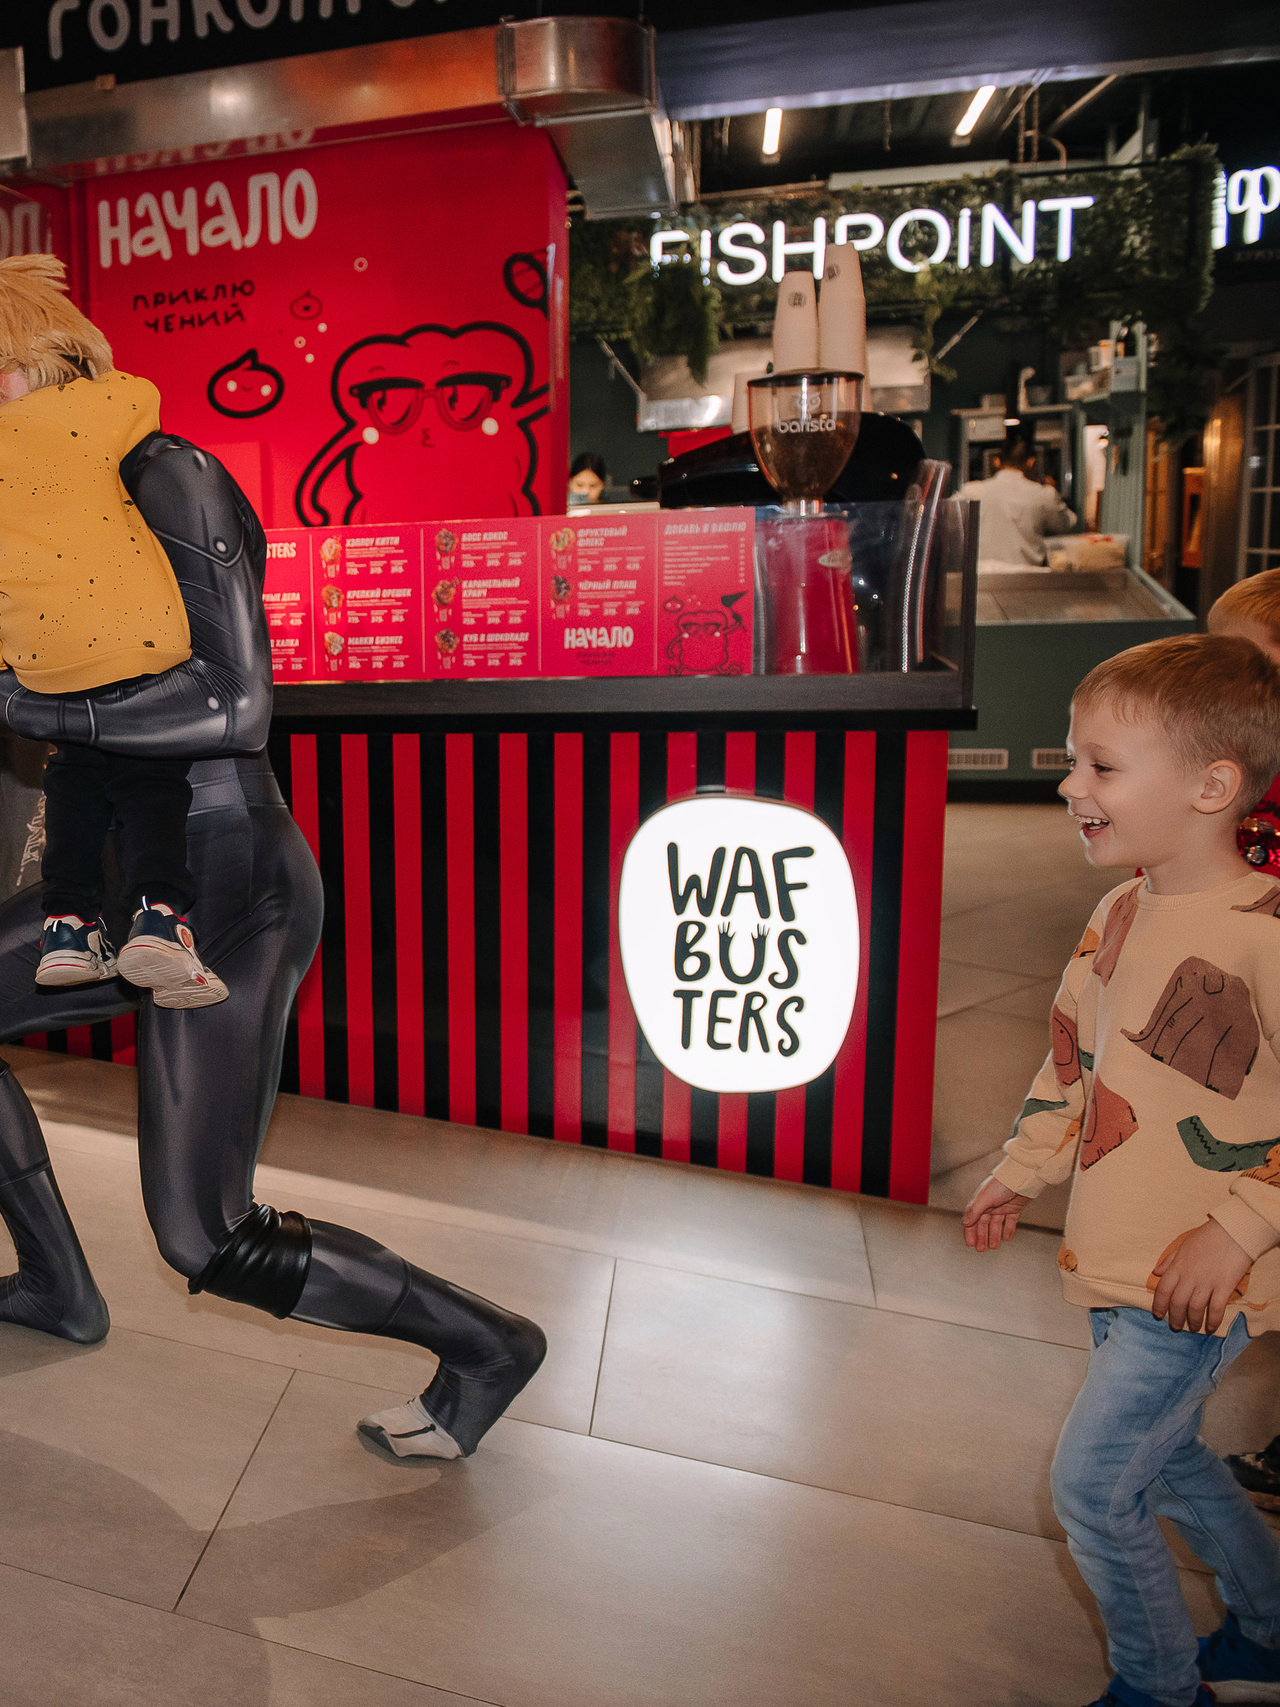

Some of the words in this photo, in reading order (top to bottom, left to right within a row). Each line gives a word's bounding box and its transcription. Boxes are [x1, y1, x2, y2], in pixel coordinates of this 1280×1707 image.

[133, 280, 254, 311] ПРИКЛЮ
[144, 303, 246, 333] ЧЕНИЙ
[777, 415, 837, 433] barista
[667, 842, 815, 922] WAF
[674, 920, 807, 989] BUS
[673, 989, 804, 1057] TERS
